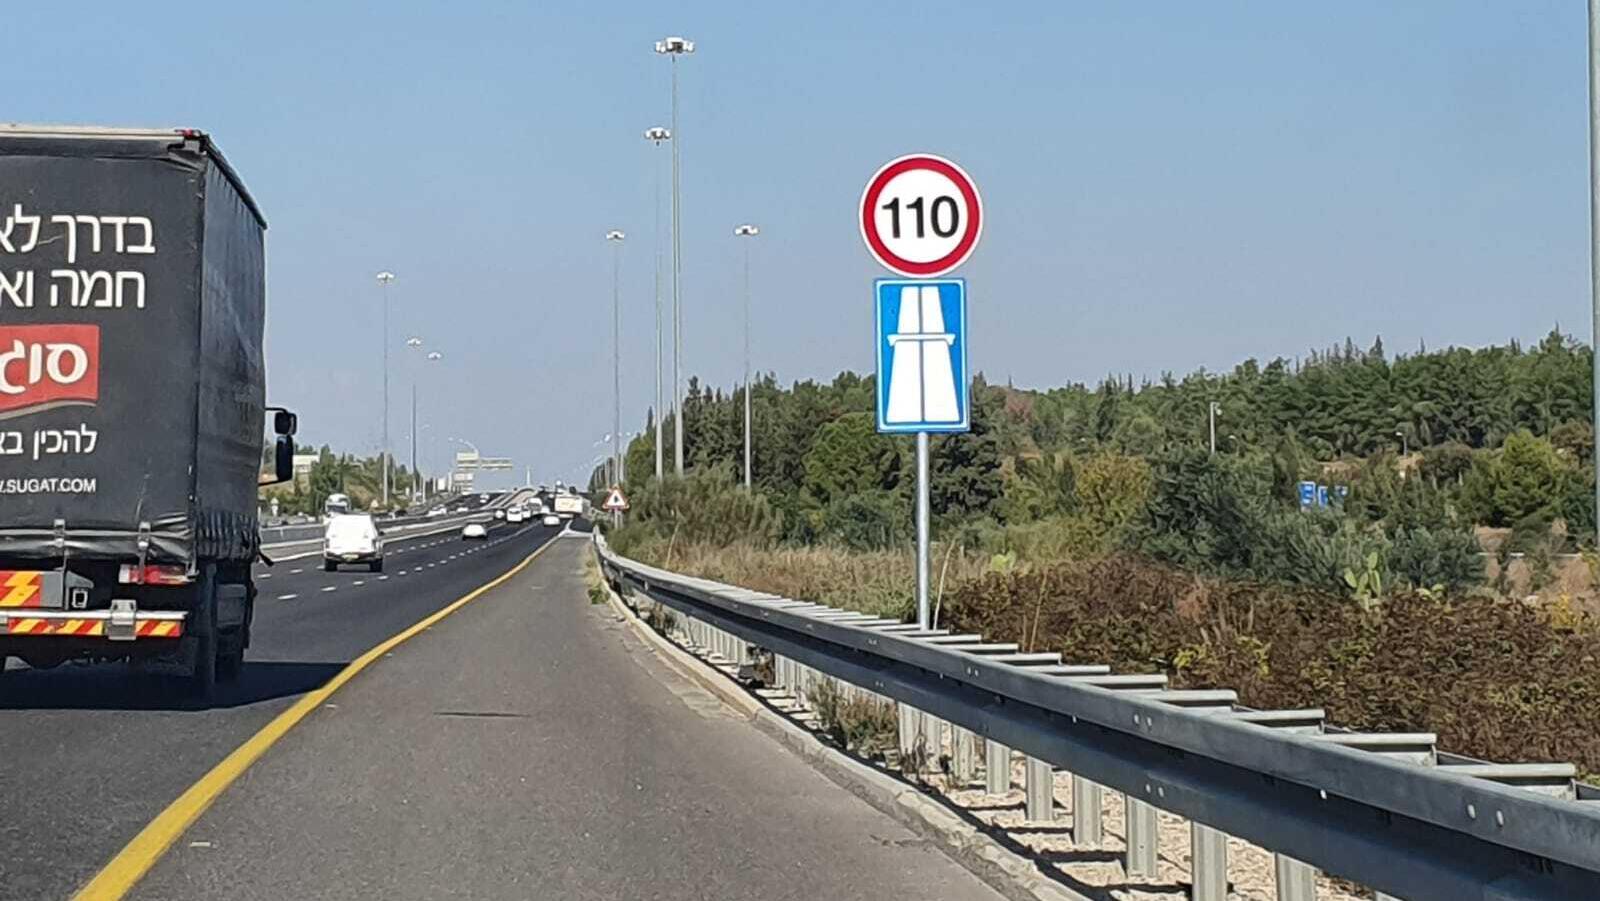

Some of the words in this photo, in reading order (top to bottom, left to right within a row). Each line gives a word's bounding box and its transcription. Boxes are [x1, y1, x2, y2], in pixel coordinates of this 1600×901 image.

[882, 195, 959, 239] 110
[50, 214, 156, 264] בדרך
[50, 269, 145, 308] חמה
[33, 423, 98, 460] להכין
